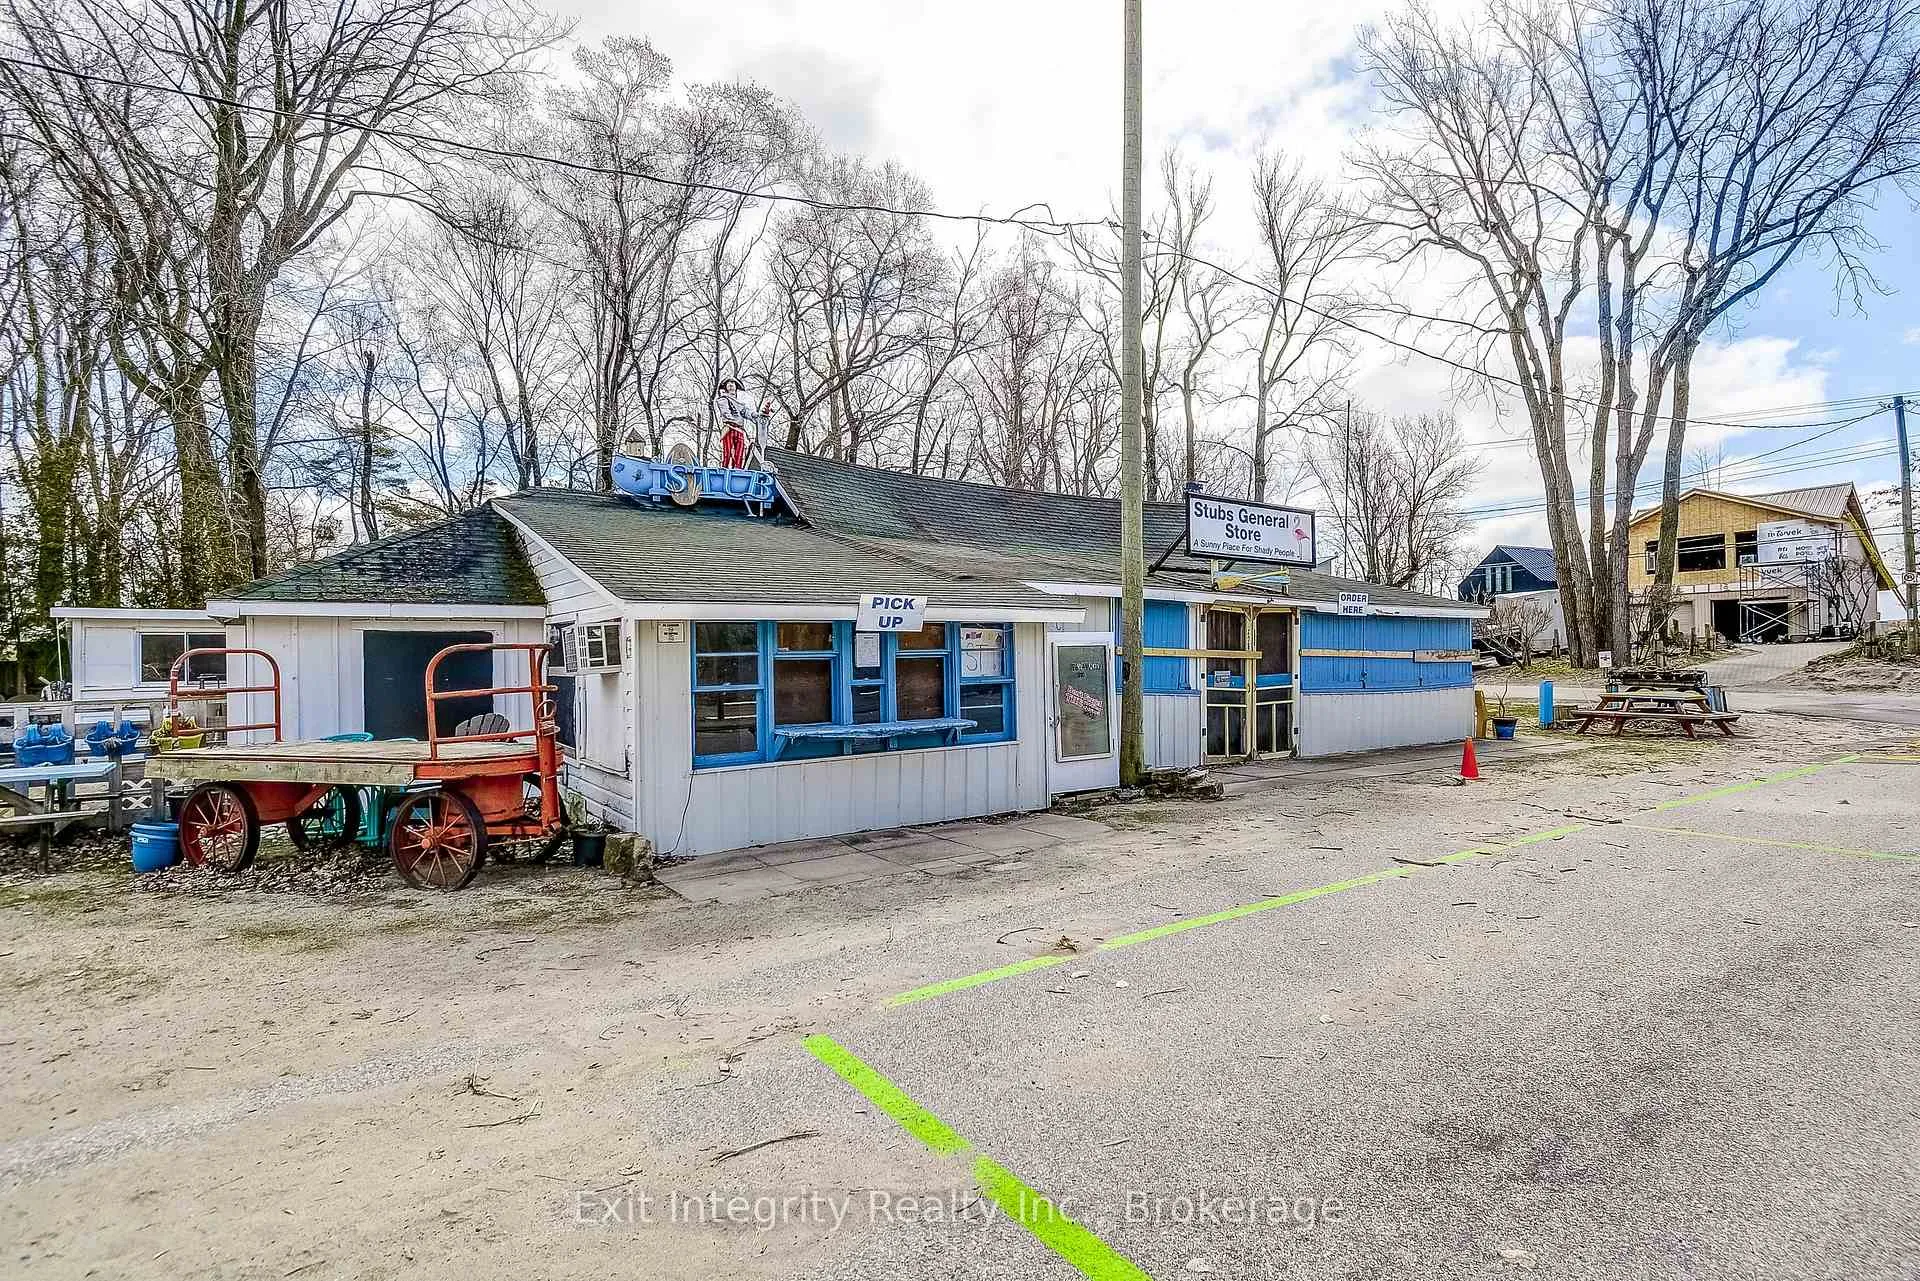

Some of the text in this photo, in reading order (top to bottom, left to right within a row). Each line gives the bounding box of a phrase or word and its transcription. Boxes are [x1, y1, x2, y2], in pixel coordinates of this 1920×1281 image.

[1194, 501, 1289, 528] Stubs General
[1225, 523, 1261, 541] Store
[1193, 538, 1295, 557] A Sunny Place For Shady People
[871, 596, 916, 610] PICK
[1340, 593, 1367, 603] ORDER
[1342, 605, 1364, 614] HERE
[878, 615, 904, 629] UP
